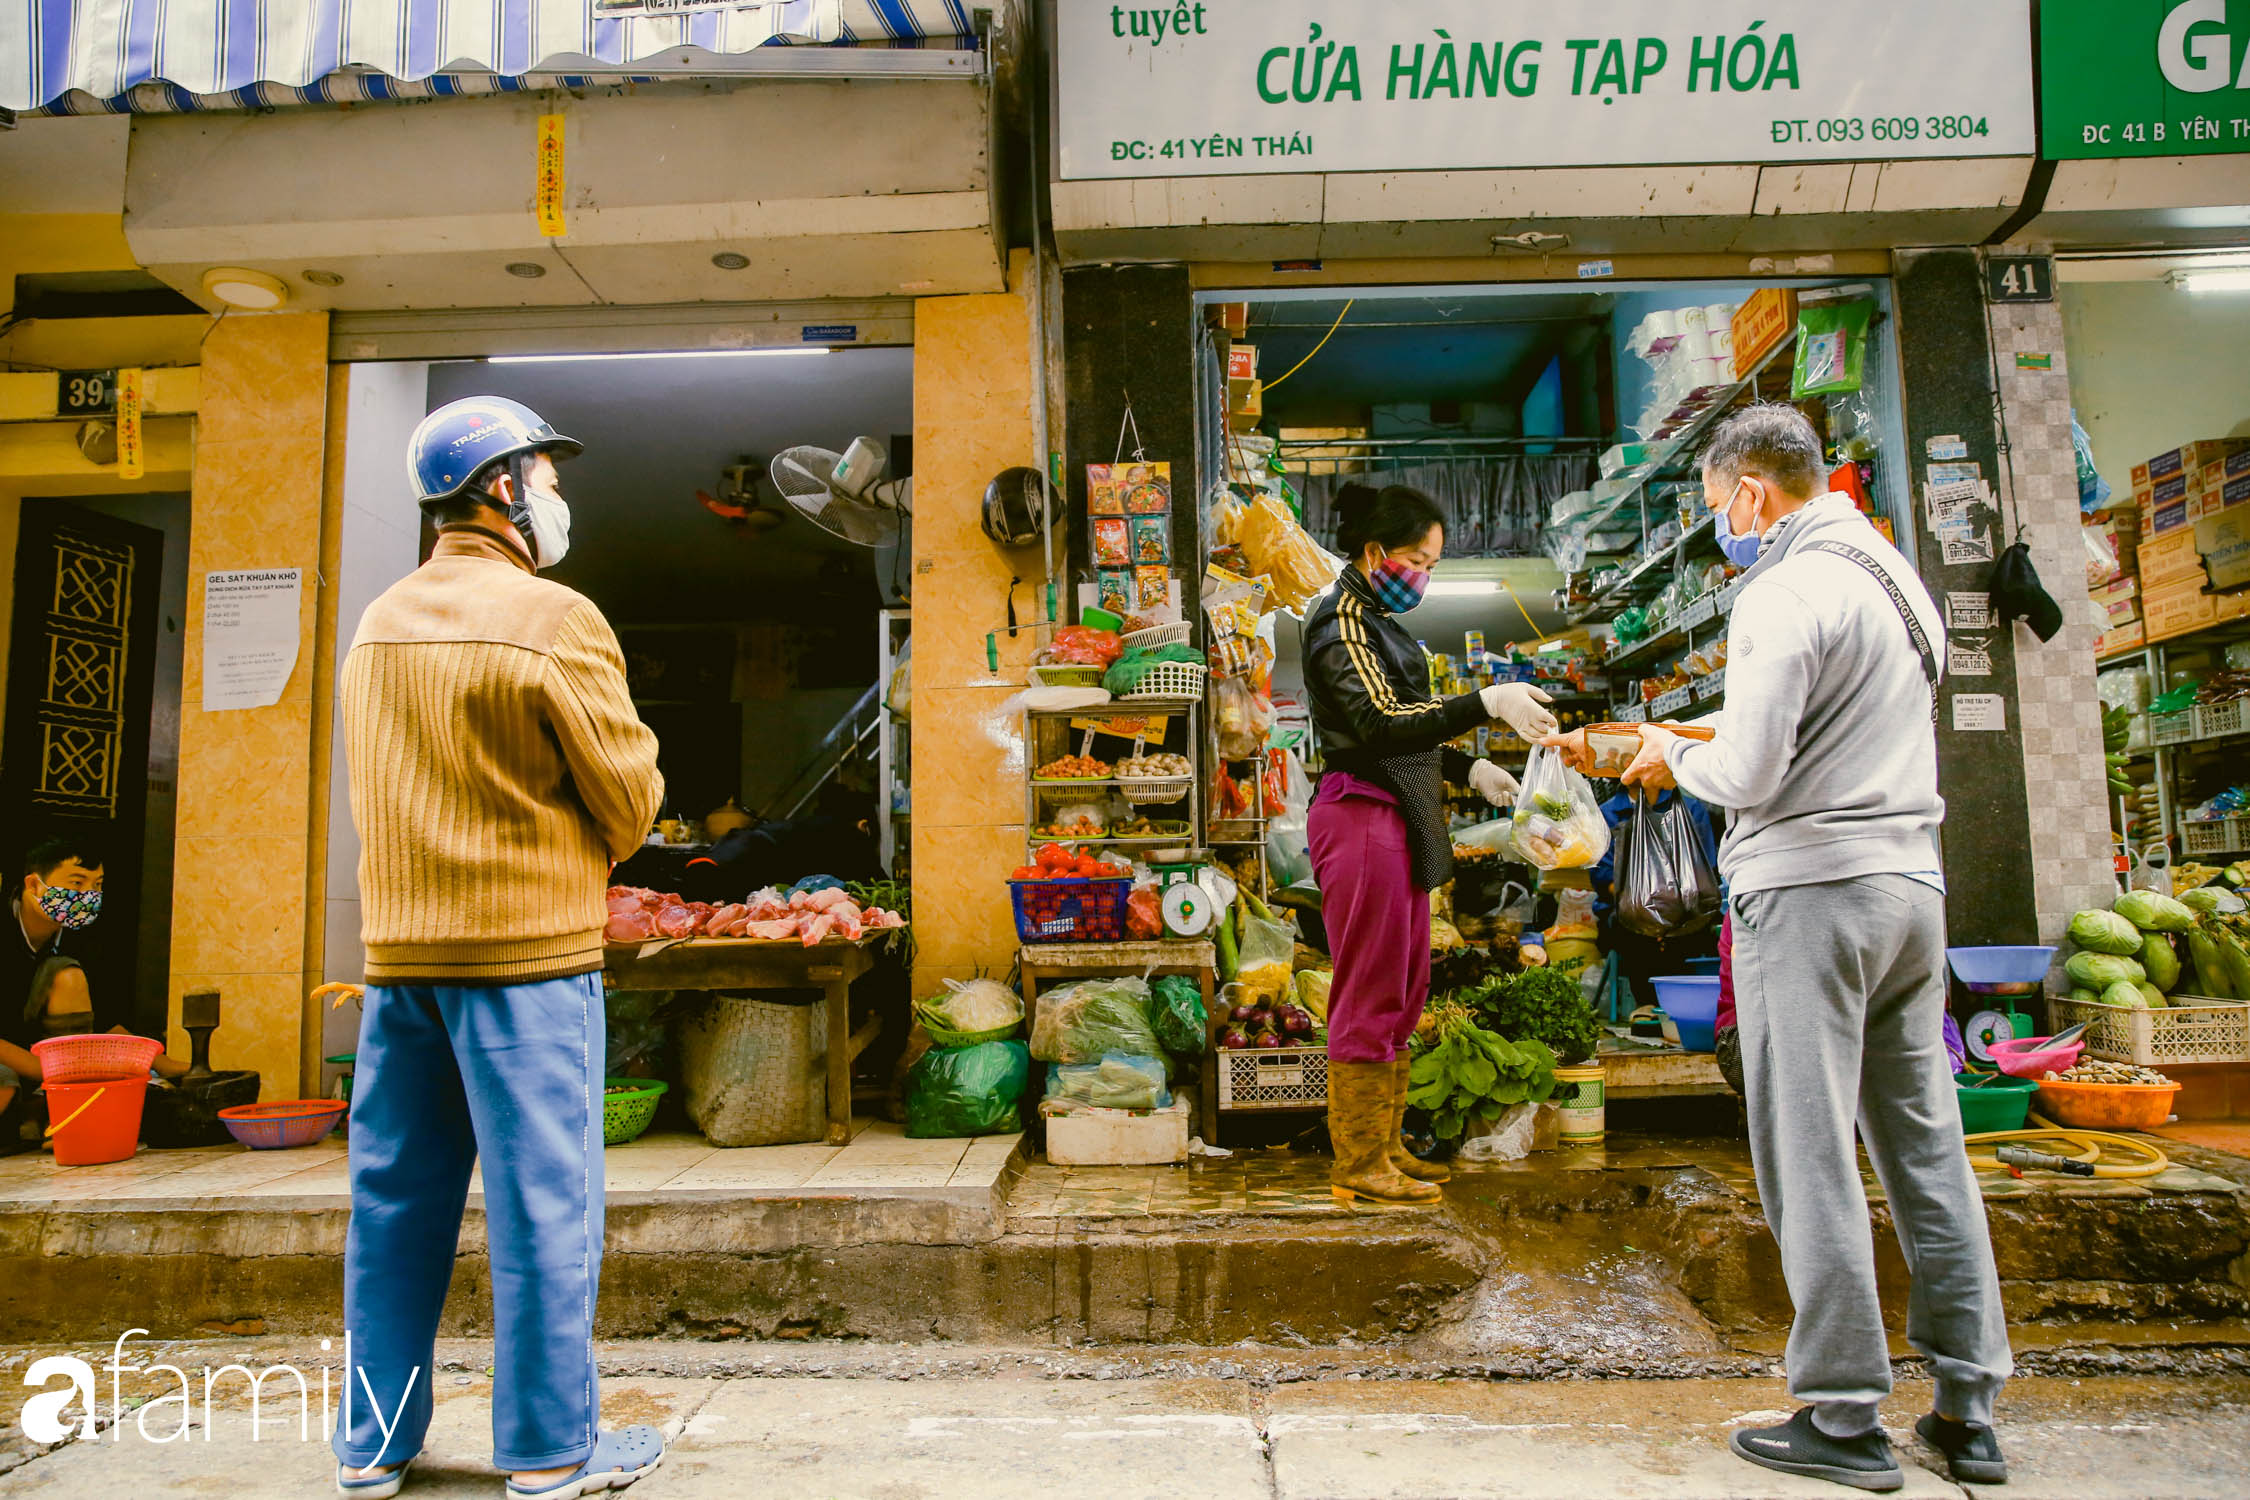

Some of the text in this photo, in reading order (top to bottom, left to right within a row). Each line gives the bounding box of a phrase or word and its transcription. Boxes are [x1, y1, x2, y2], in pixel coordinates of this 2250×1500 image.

[2158, 0, 2250, 93] G
[1257, 20, 1800, 104] CỬA HÀNG TẠP HÓA
[1771, 115, 1989, 143] ĐT. 093 609 3804
[2083, 124, 2111, 144] ĐC
[2122, 123, 2146, 142] 41
[2153, 122, 2165, 141] B
[2180, 115, 2220, 140] YÊN
[1112, 131, 1313, 161] ĐC: 41 YÊN THÁI
[2001, 264, 2038, 294] 41
[68, 377, 104, 407] 39
[208, 575, 225, 583] GEL
